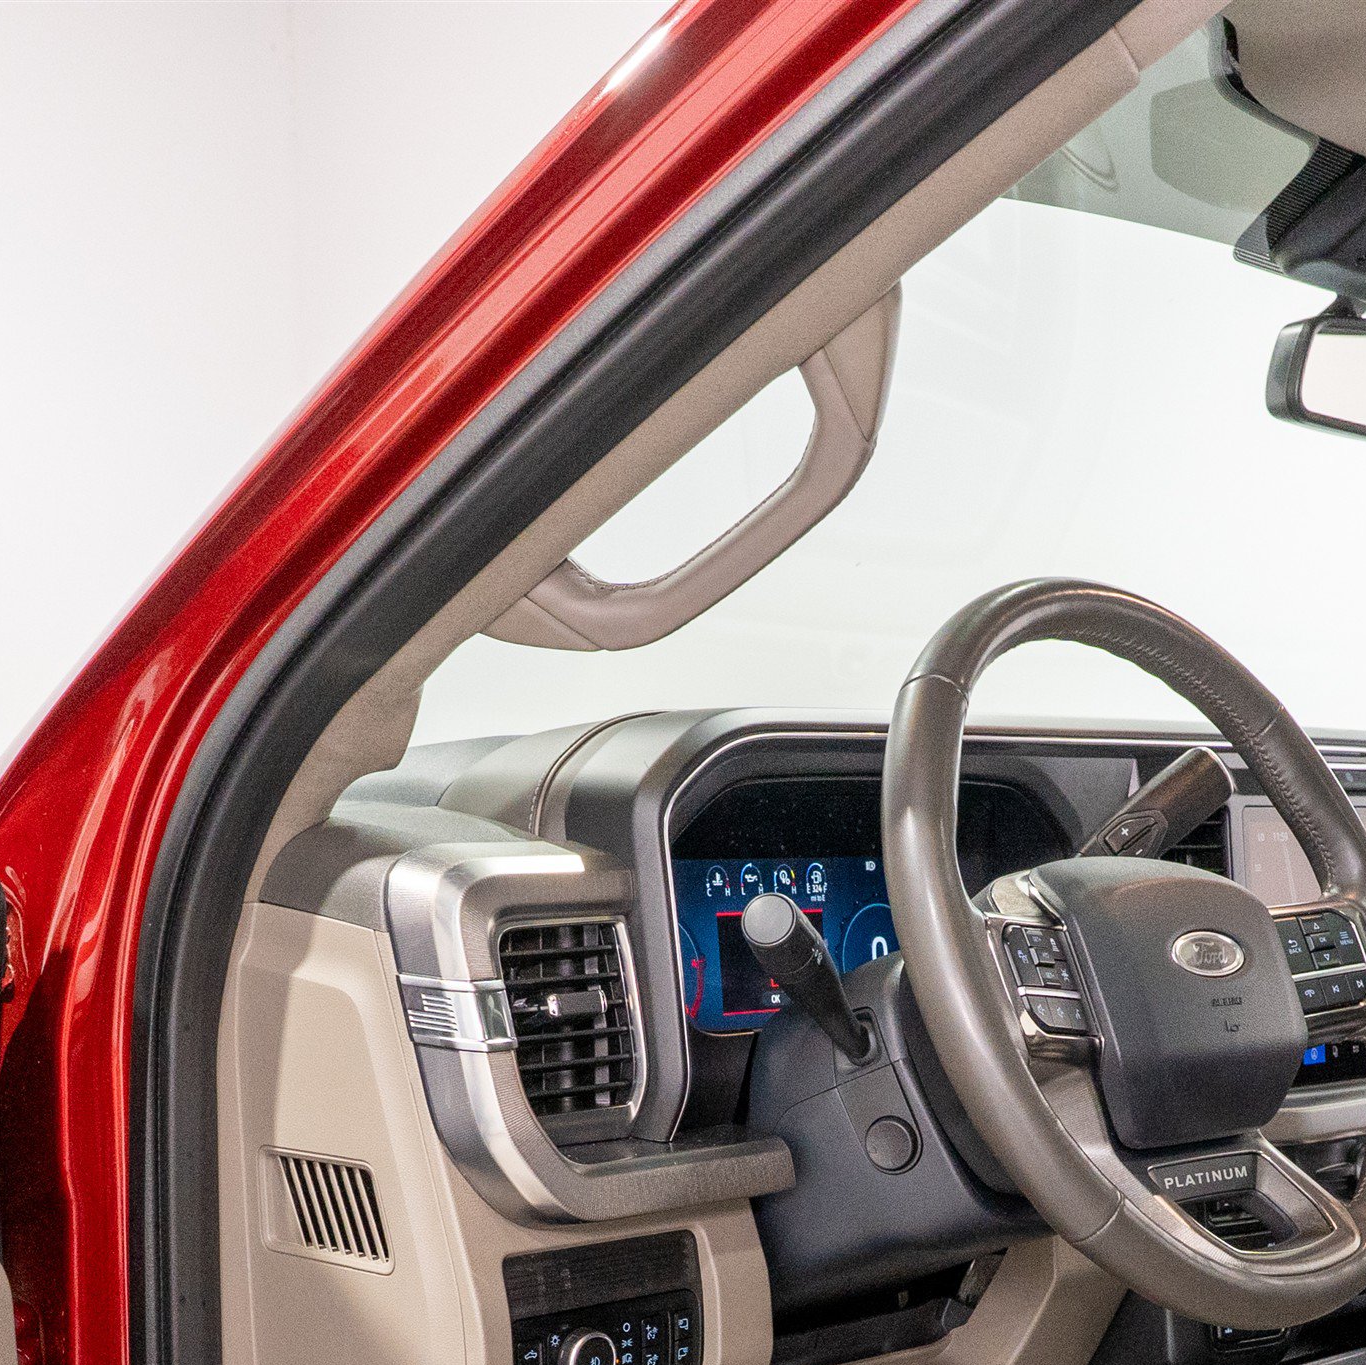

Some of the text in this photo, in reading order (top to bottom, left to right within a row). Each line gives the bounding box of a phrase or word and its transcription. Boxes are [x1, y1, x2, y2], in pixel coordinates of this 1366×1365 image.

[1192, 941, 1228, 965] Ford
[1288, 947, 1302, 955] BACK
[771, 994, 781, 1003] OK
[1164, 1166, 1248, 1190] PLATINUM
